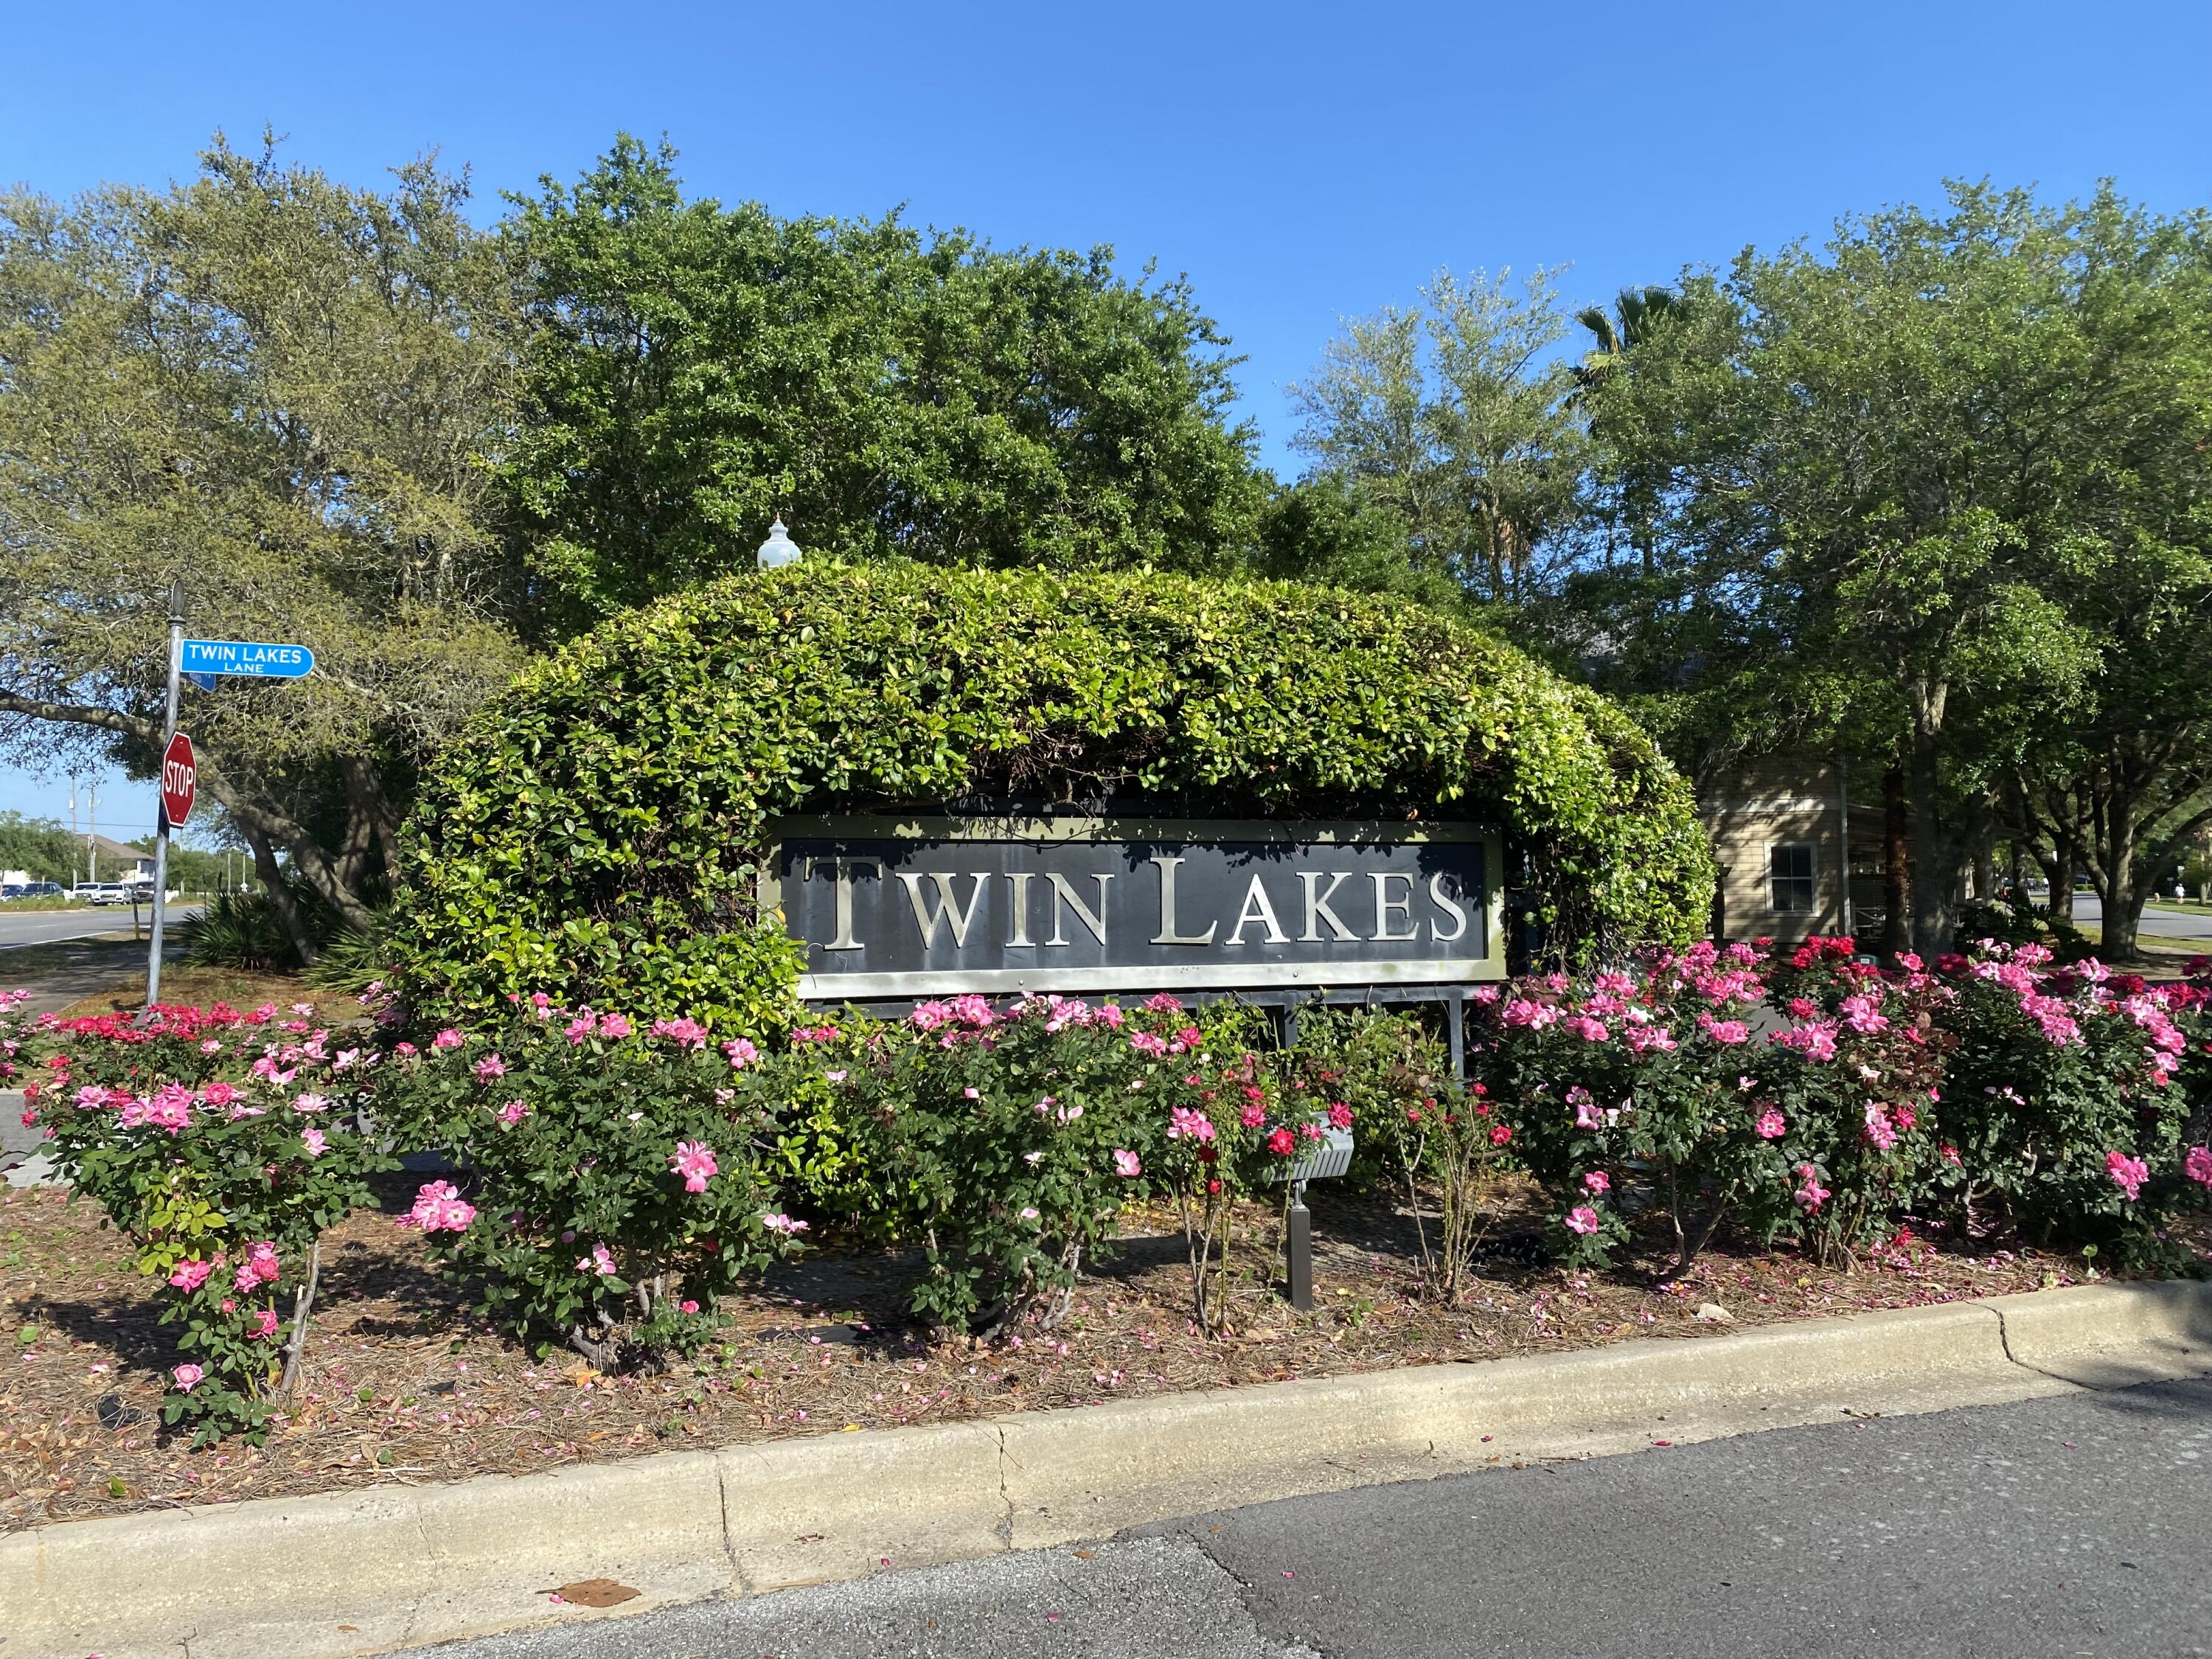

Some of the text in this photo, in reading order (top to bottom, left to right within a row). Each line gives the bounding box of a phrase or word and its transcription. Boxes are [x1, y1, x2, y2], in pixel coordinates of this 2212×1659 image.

[188, 644, 302, 664] TWIN LAKES
[224, 663, 264, 673] LANE
[165, 759, 193, 797] STOP
[803, 855, 1467, 950] TWIN LAKES
